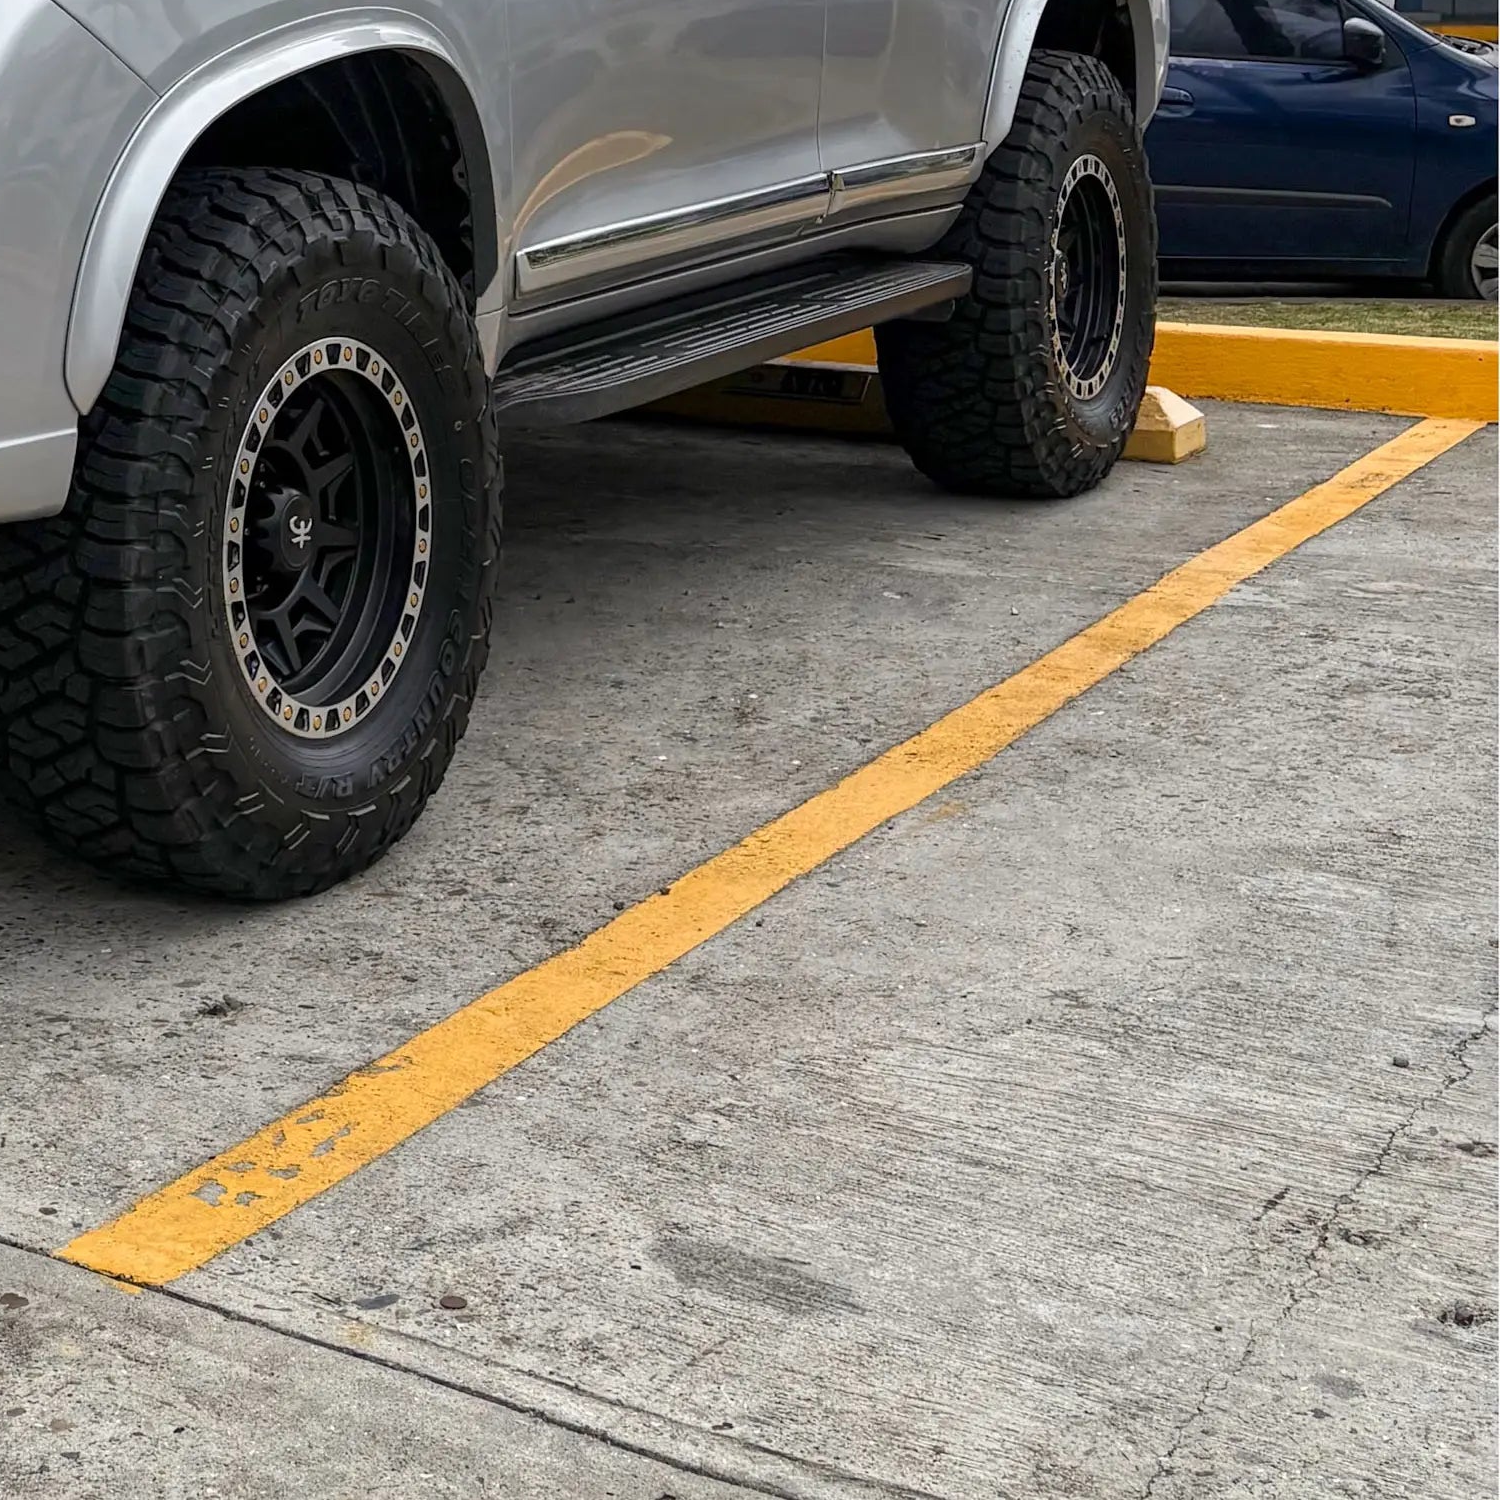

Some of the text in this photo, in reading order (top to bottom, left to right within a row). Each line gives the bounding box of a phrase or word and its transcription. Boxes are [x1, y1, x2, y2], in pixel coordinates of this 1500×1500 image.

[296, 276, 381, 324] TOYO
[366, 608, 465, 789] COUNTRY
[293, 771, 355, 799] R/T
